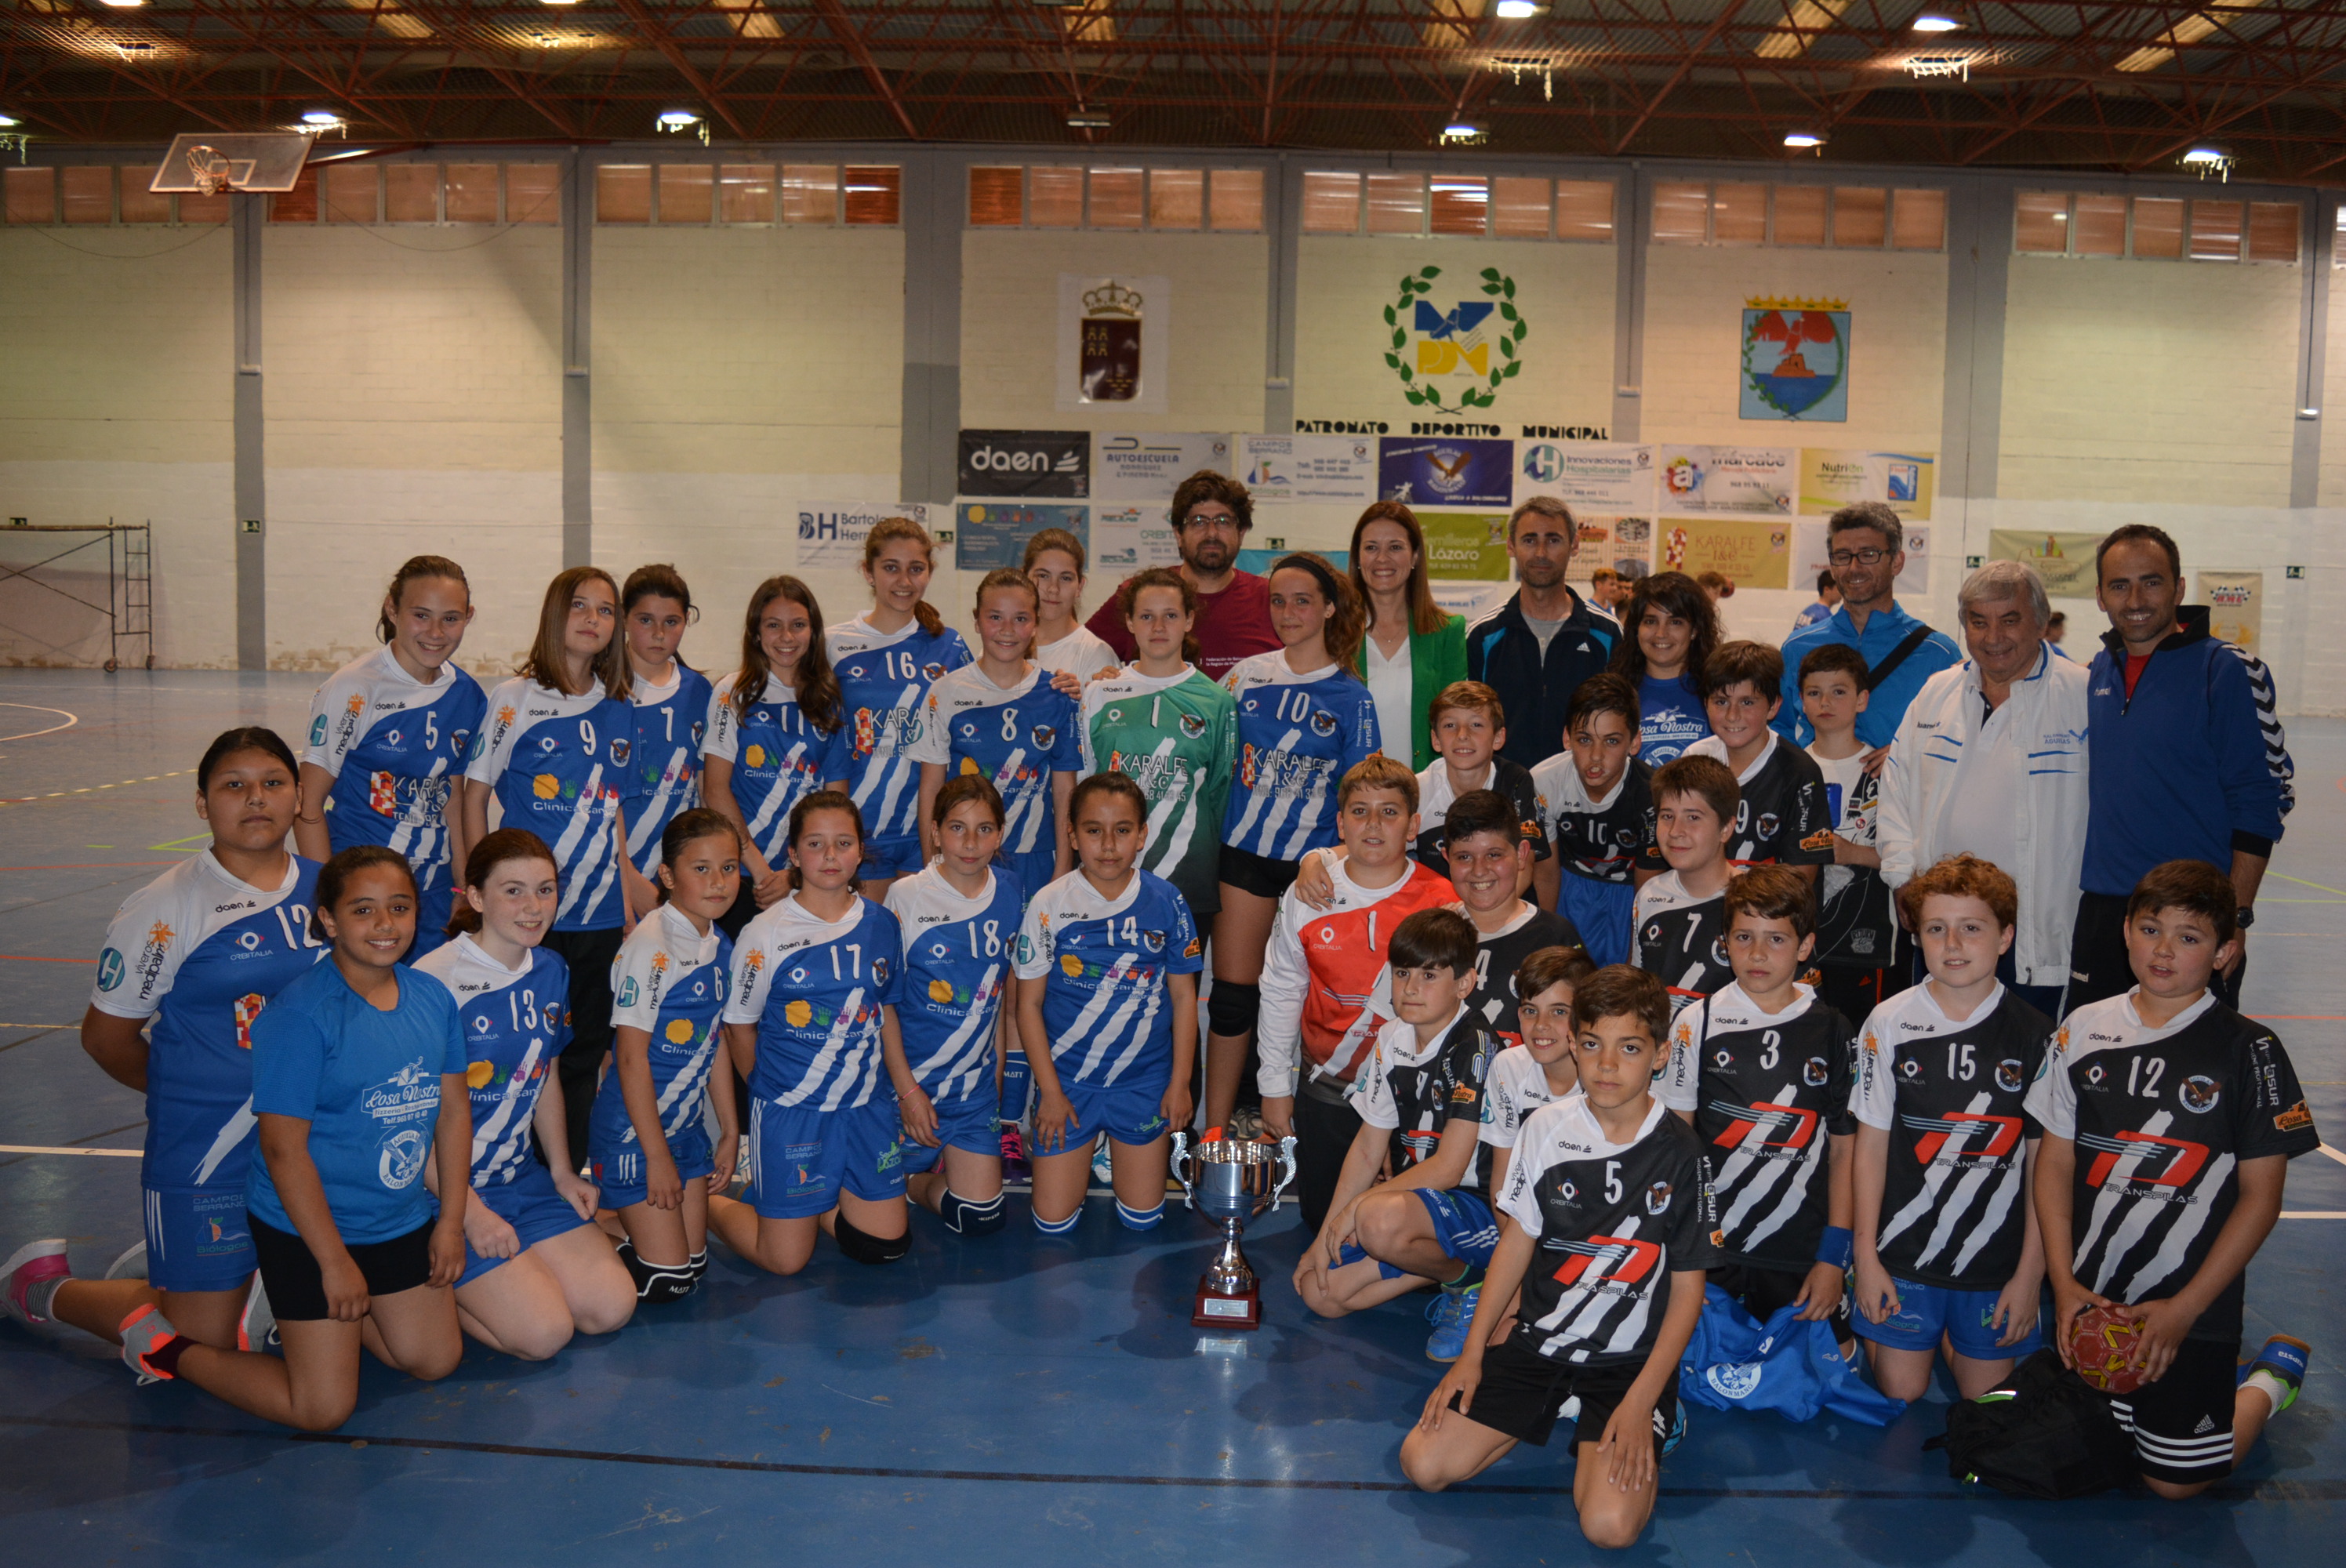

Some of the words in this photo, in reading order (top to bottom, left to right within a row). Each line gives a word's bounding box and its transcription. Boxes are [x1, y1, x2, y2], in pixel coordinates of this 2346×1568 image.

[1295, 419, 1389, 435] PATRONATO
[1411, 422, 1501, 437] DEPORTIVO
[1522, 425, 1609, 441] MUNICIPAL
[971, 445, 1049, 472] daen
[1106, 454, 1179, 463] AUTOESCUELA
[1567, 456, 1632, 466] Innovaciones
[1695, 535, 1756, 551] KARALFE
[885, 651, 917, 681] 16
[375, 702, 396, 711] daen
[1151, 695, 1161, 728] 1
[1276, 688, 1310, 723] 10
[336, 707, 351, 735] viveros
[426, 710, 439, 751] 5
[660, 706, 674, 742] 7
[781, 705, 804, 736] 11
[1001, 707, 1019, 742] 8
[1660, 721, 1703, 733] Nostra
[376, 743, 408, 753] ORBITALIA
[579, 719, 597, 757] 9
[1119, 753, 1189, 776] KARALFE
[1139, 773, 1169, 789] I&C
[216, 901, 245, 913] daen
[275, 904, 323, 950] 12
[918, 915, 940, 924] daen
[968, 919, 1000, 959] 18
[1106, 916, 1138, 947] 14
[1367, 910, 1377, 952] 1
[1683, 912, 1702, 953] 7
[230, 949, 274, 961] ORBITALIA
[778, 941, 801, 951] daen
[136, 940, 155, 975] viveros
[830, 943, 861, 981] 17
[139, 943, 166, 1001] medipalm
[1475, 949, 1491, 991] 4
[714, 966, 724, 1002] 6
[510, 989, 537, 1033] 13
[1901, 1022, 1923, 1031] daen
[467, 1033, 499, 1042] ORBITALIA
[2089, 1033, 2111, 1042] daen
[1393, 1047, 1411, 1059] daen
[1760, 1029, 1781, 1070] 3
[1707, 1066, 1738, 1076] ORBITALIA
[1947, 1042, 1976, 1081] 15
[1896, 1076, 1926, 1086] RBITALIA
[2127, 1055, 2166, 1098] 12
[469, 1091, 510, 1102] línica
[2080, 1083, 2109, 1092] RBITALIA
[2279, 1113, 2303, 1126] Cosa
[1559, 1140, 1582, 1152] daen
[1738, 1145, 1811, 1163] TRANSPILAS
[1936, 1157, 2017, 1170] TRANSPILAS
[1604, 1160, 1623, 1204] 5
[2104, 1181, 2199, 1204] TRANSPILAS
[1550, 1198, 1582, 1210] ORBITALIA
[196, 1242, 249, 1254] Biólogos
[668, 1285, 690, 1294] MATT
[1710, 1377, 1754, 1397] BALONMANO
[2194, 1422, 2215, 1434] adidas
